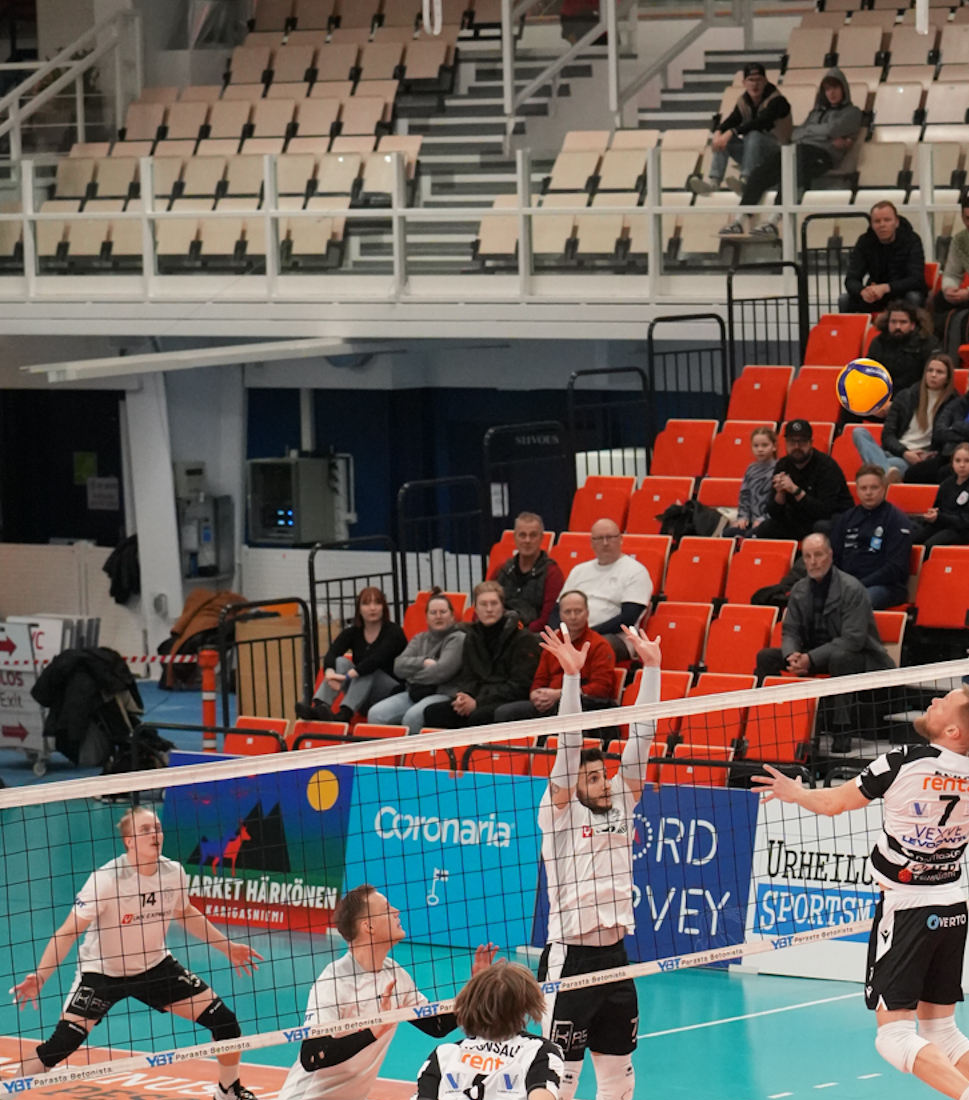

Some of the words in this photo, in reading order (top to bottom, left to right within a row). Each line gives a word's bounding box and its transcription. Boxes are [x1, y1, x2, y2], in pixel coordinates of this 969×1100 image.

[0, 671, 24, 687] LOS
[938, 794, 961, 827] 7
[374, 805, 512, 848] Coronaria
[768, 840, 879, 885] URHEILU
[139, 892, 157, 909] 14
[245, 875, 338, 910] HÄRKÖNEN
[634, 884, 731, 936] VEY
[760, 889, 879, 931] SPORTSM
[938, 914, 967, 928] VERTO
[771, 935, 795, 949] YBT
[657, 958, 682, 972] YBT
[413, 1003, 440, 1018] YBT
[283, 1026, 311, 1042] YBT
[311, 1023, 343, 1036] Parasta
[146, 1052, 176, 1068] YBT
[175, 1048, 208, 1061] Parasta
[461, 1052, 505, 1072] rent
[3, 1077, 34, 1094] YBT
[34, 1075, 68, 1087] Parasta
